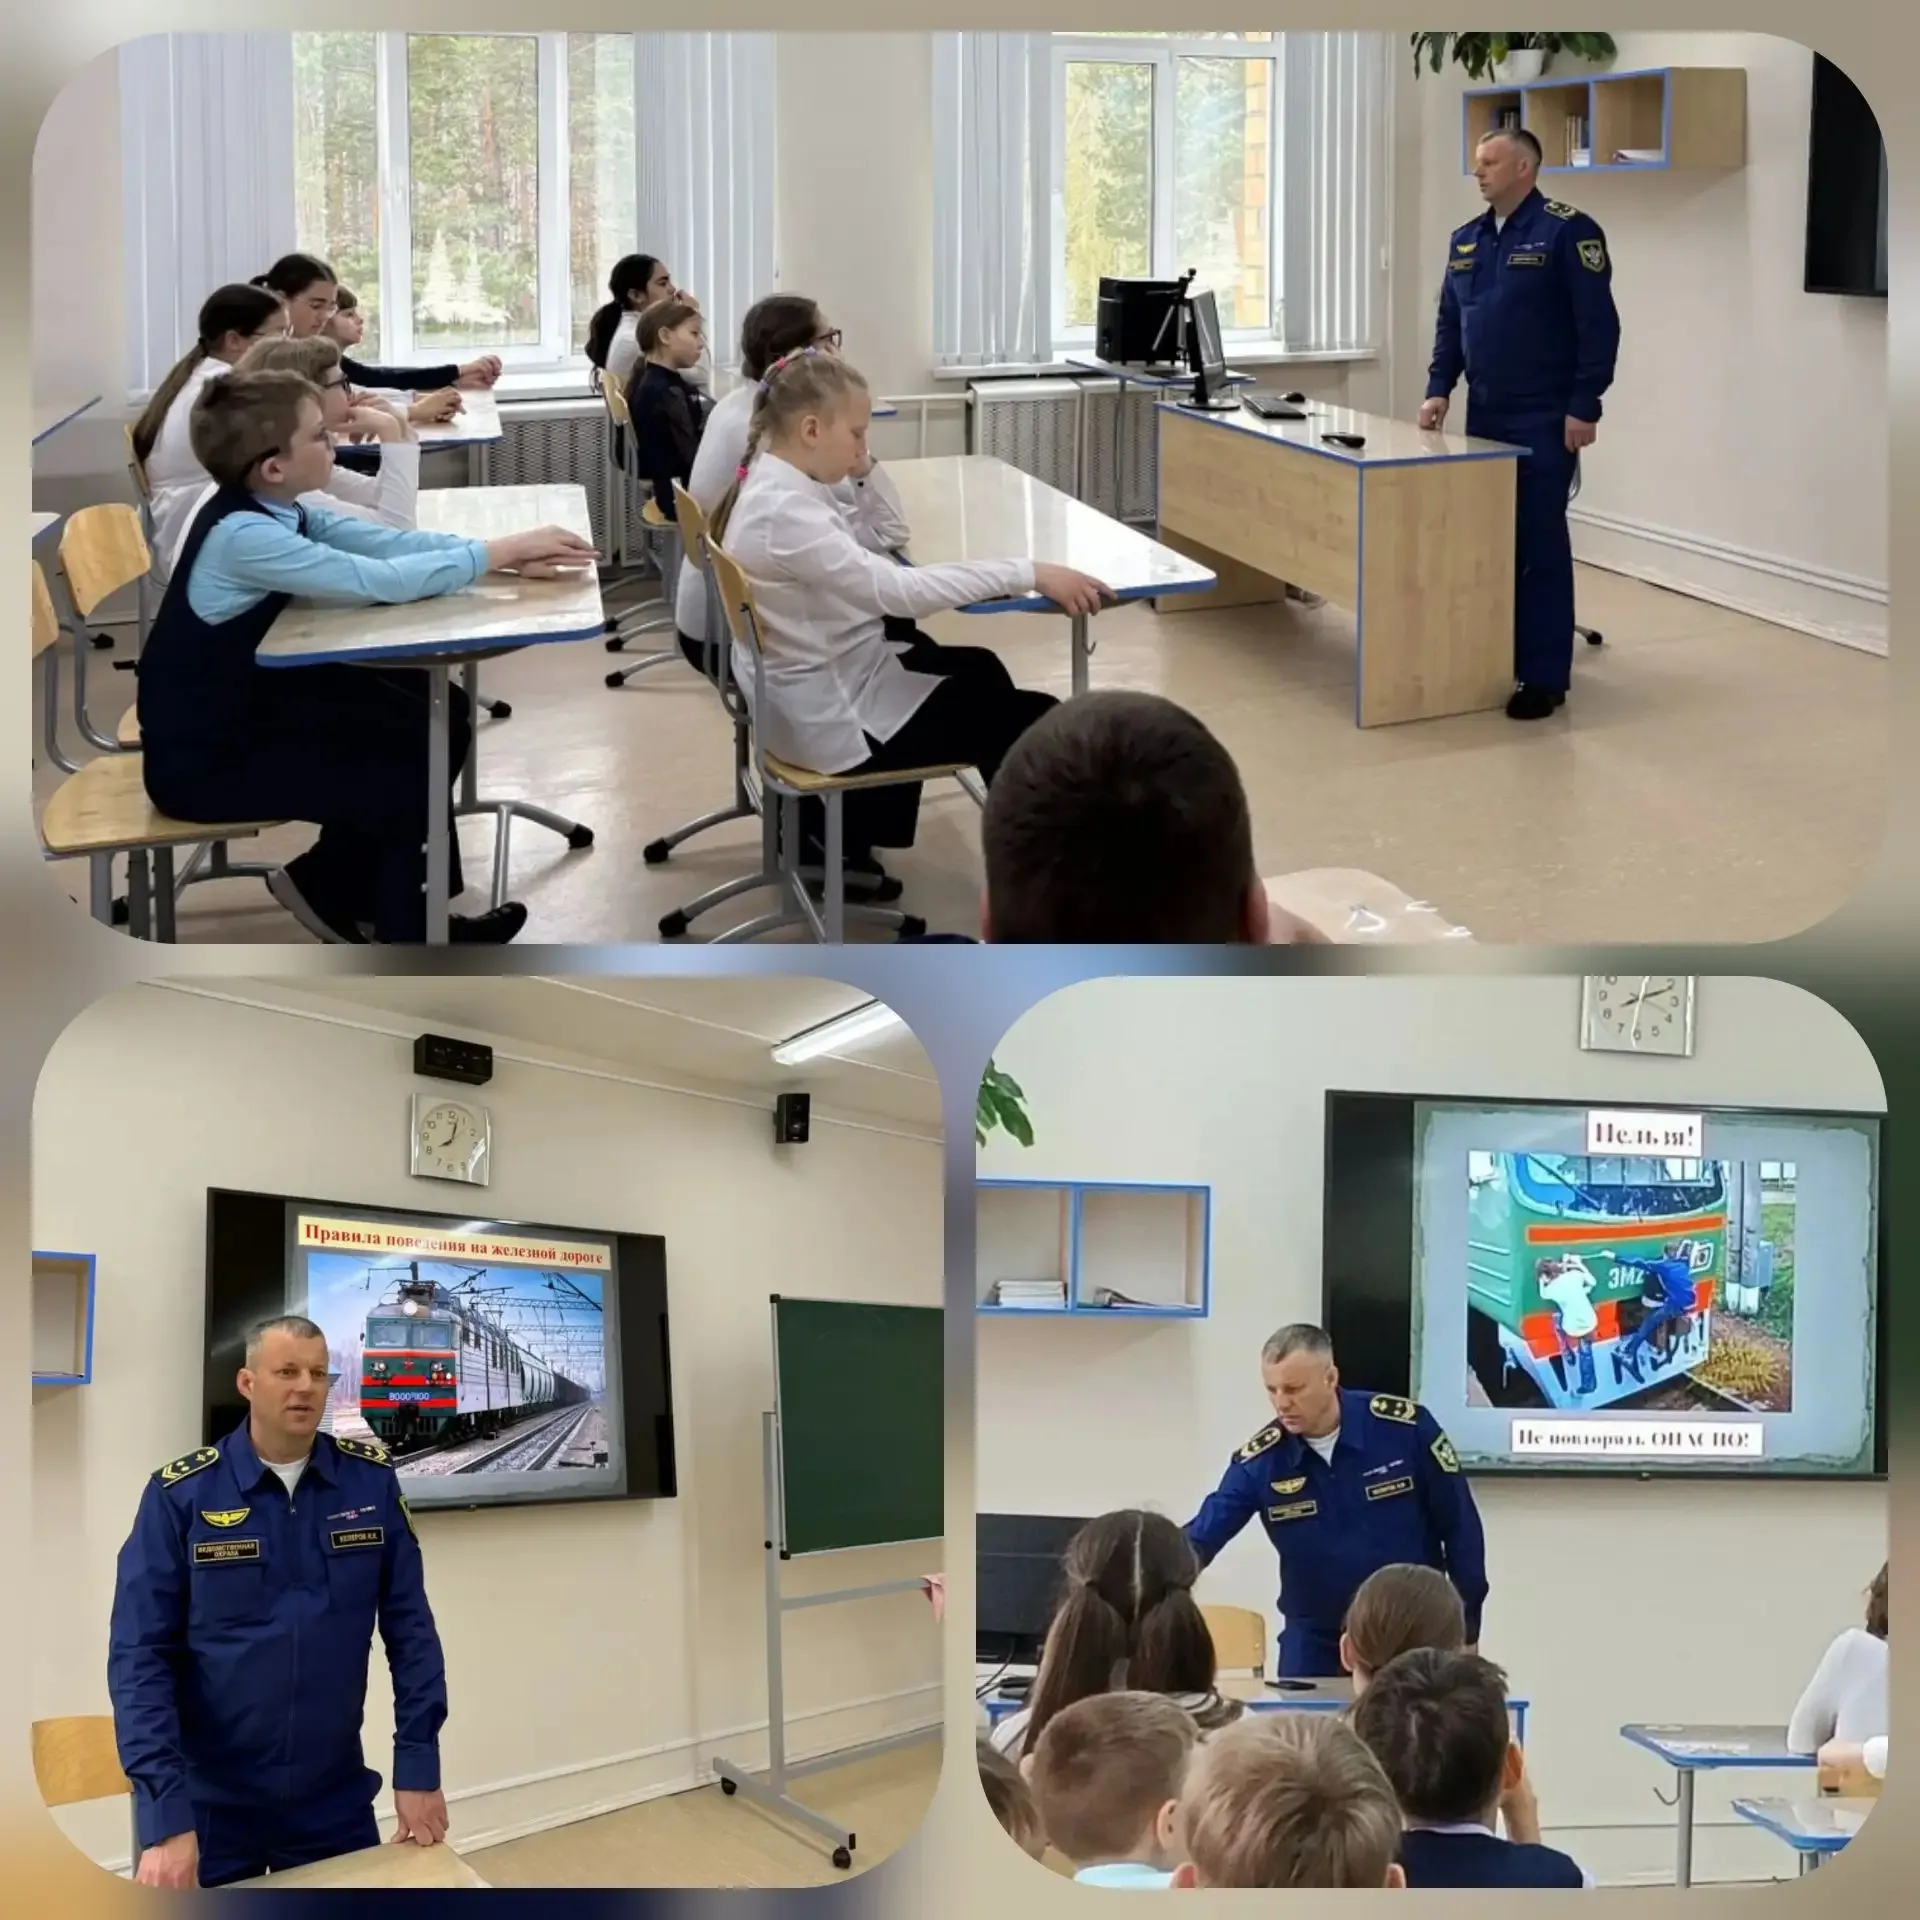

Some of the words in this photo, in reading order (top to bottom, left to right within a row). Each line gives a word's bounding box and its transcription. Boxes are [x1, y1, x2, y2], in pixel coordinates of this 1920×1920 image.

[304, 1223, 381, 1244] Правила
[386, 1234, 466, 1253] поведения
[471, 1243, 488, 1254] на
[491, 1245, 557, 1261] железной
[559, 1250, 603, 1265] дороге
